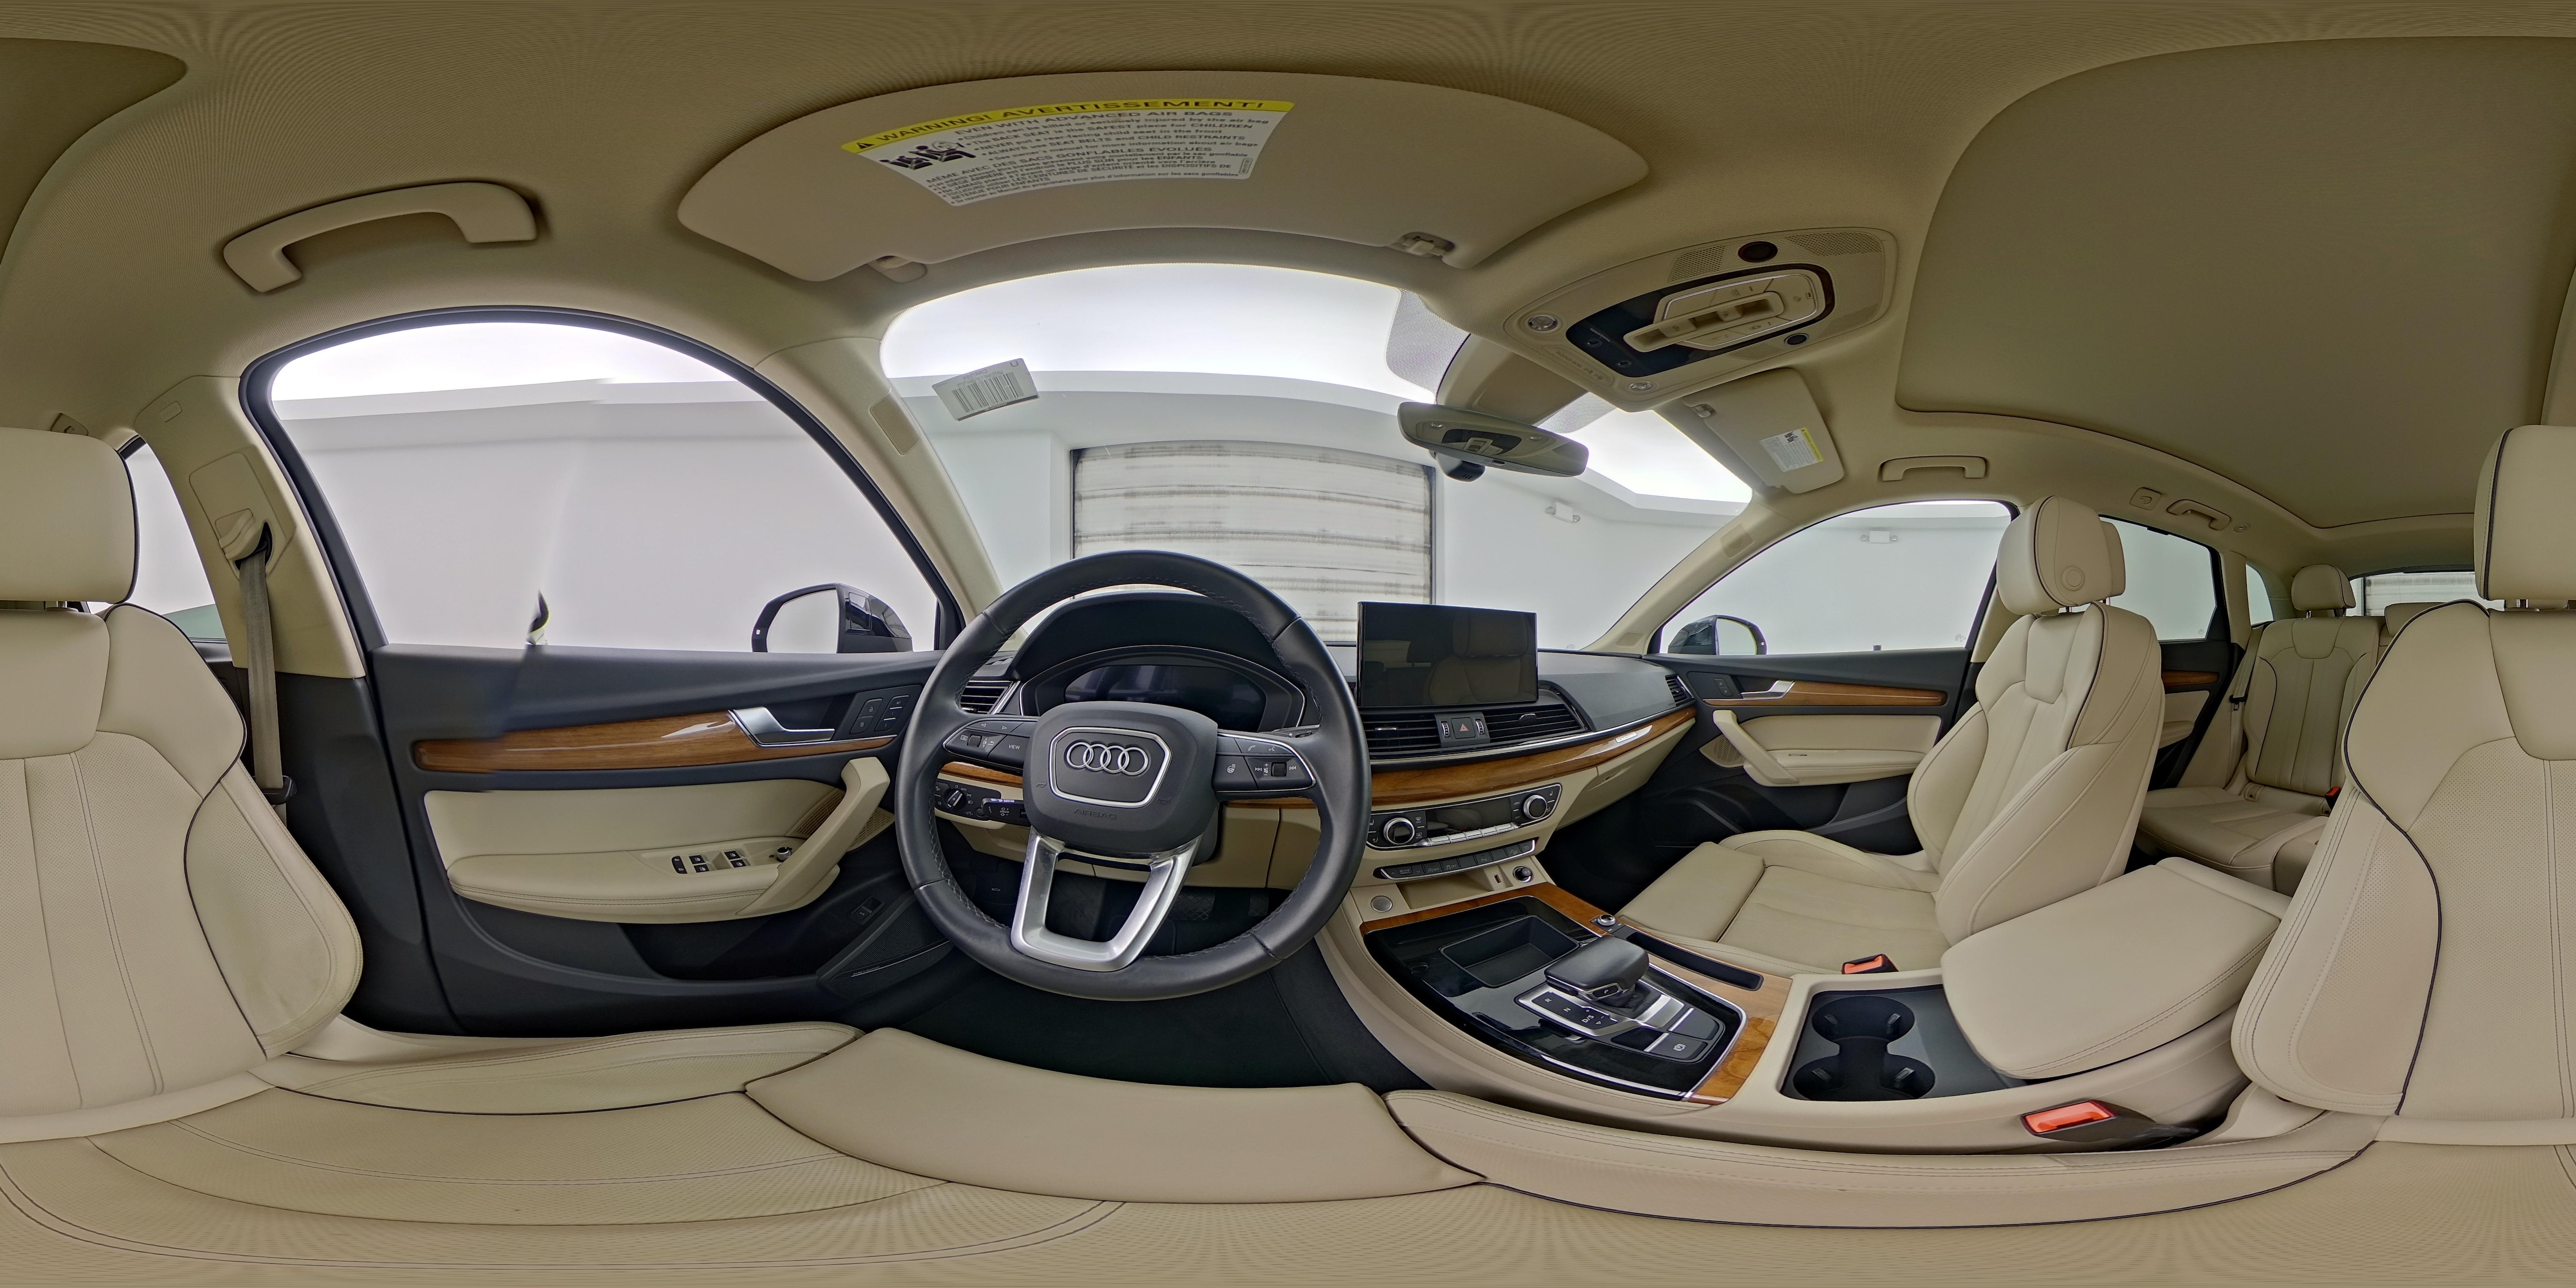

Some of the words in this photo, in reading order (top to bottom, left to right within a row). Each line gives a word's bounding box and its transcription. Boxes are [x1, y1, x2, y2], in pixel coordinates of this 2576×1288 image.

[876, 114, 993, 141] WARNING!
[997, 101, 1264, 117] AVERTISSEMENT!
[953, 125, 994, 134] EVEN
[994, 119, 1040, 128] WITH
[1042, 112, 1141, 122] ADVANCED
[986, 146, 1028, 155] ALWAYS
[1074, 809, 1117, 820] AIRBAG
[1581, 1014, 1595, 1023] D/S
